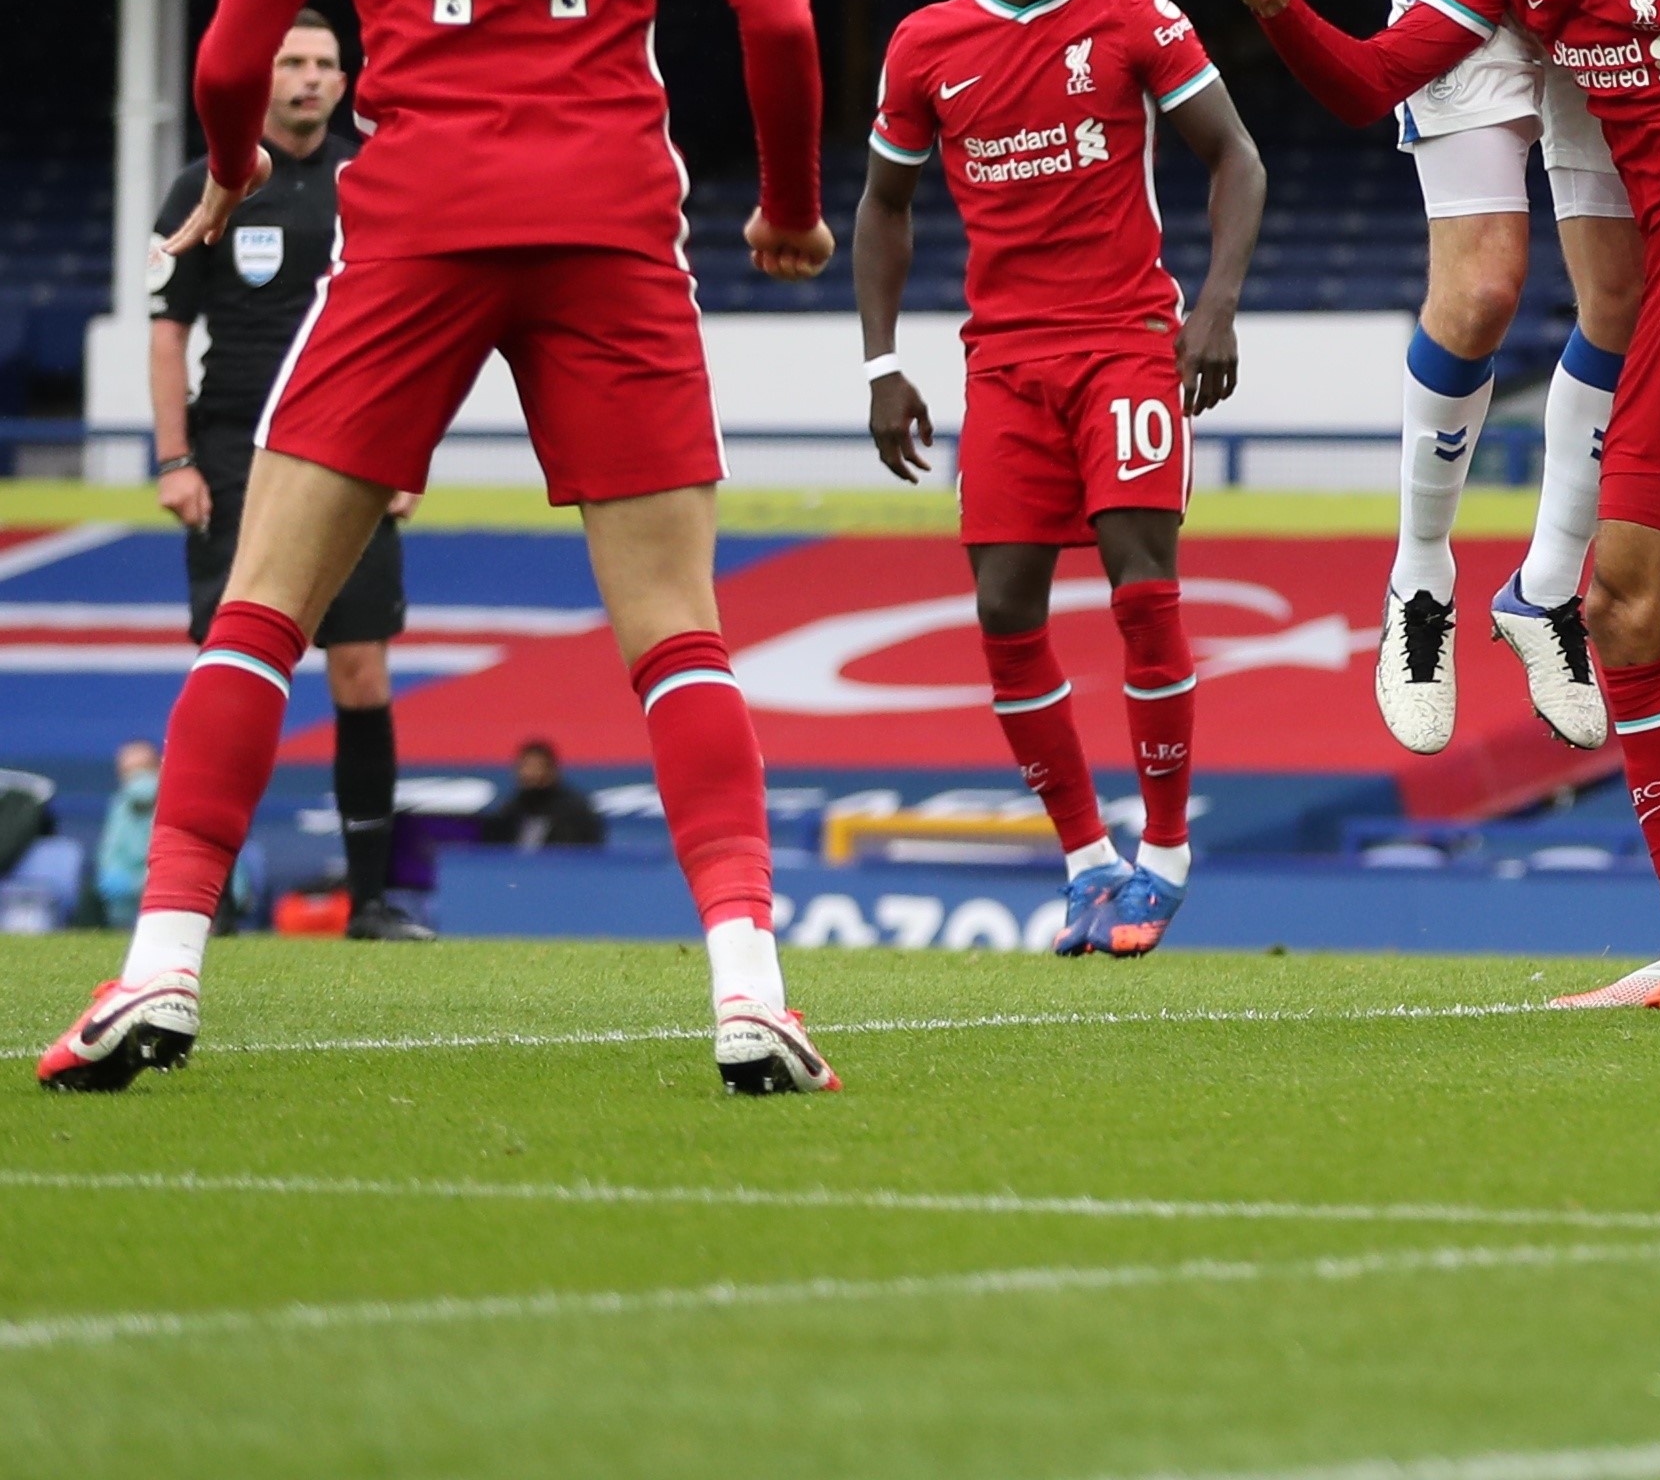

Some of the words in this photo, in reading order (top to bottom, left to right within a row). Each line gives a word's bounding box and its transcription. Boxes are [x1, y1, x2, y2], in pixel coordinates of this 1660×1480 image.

[1552, 38, 1643, 68] Standard
[1575, 65, 1650, 89] artered
[964, 122, 1068, 159] Standard
[965, 148, 1073, 183] Chartered
[240, 231, 276, 245] FIFA
[1109, 397, 1173, 462] 10
